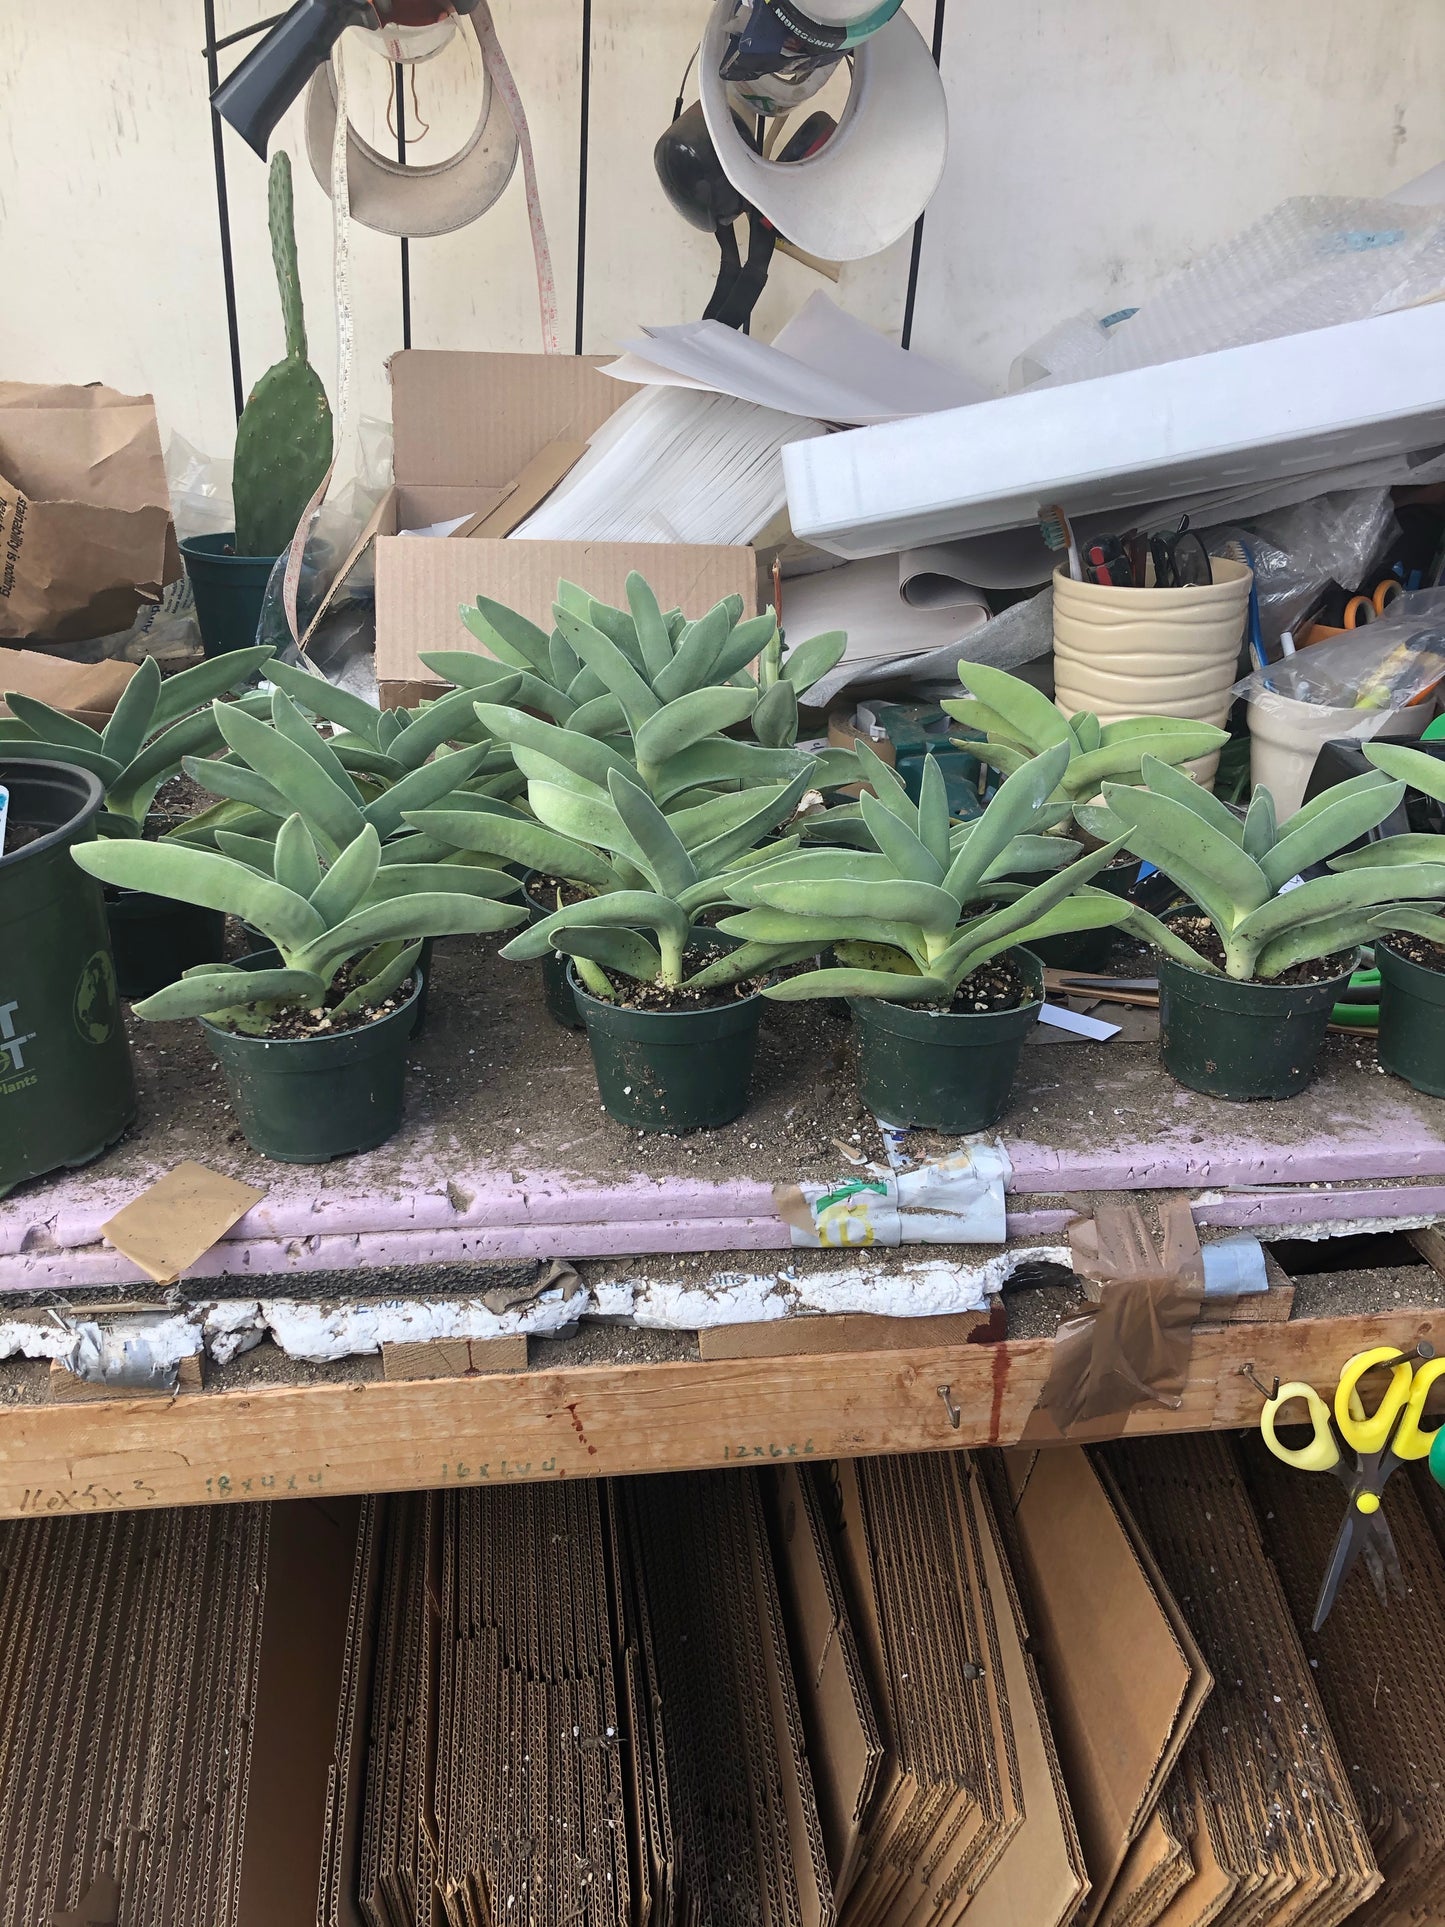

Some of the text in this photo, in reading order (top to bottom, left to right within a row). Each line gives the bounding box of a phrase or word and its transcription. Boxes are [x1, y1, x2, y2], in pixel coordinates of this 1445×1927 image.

[6, 551, 20, 562] is
[0, 561, 16, 599] nothing
[0, 1074, 38, 1095] lants
